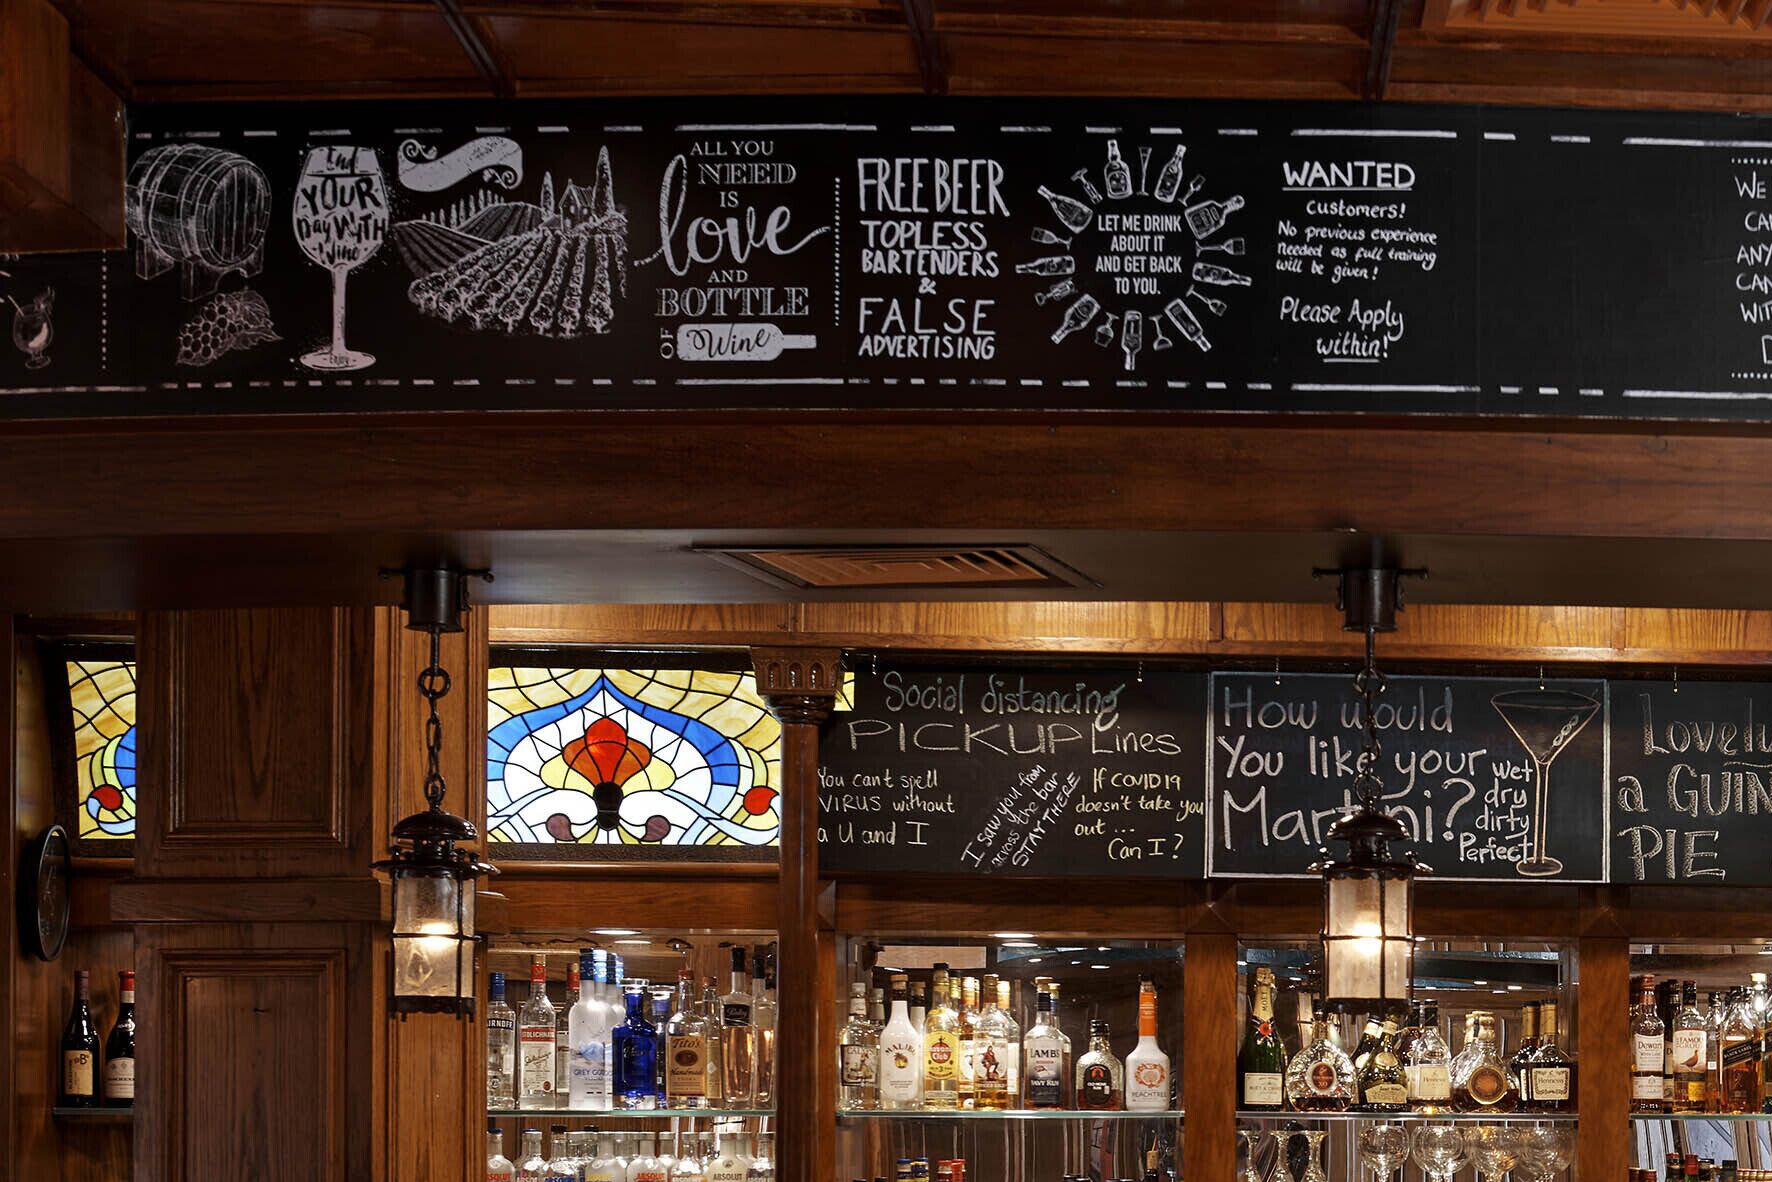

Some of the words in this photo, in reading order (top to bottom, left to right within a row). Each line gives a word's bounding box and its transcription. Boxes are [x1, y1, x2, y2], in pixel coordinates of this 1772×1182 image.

[690, 141, 727, 155] ALL
[731, 141, 774, 155] YOU
[698, 163, 797, 184] NEED
[858, 158, 929, 213] FREE
[935, 158, 1010, 217] BEER
[1282, 161, 1416, 188] WANTED
[301, 177, 381, 216] YOUR
[720, 191, 739, 207] IS
[634, 154, 831, 276] love
[1098, 214, 1119, 232] LET
[1122, 214, 1141, 232] ME
[1144, 214, 1182, 232] DRINK
[860, 220, 987, 250] TOPLESS
[1111, 235, 1150, 252] ABOUT
[1153, 235, 1165, 252] IT
[1278, 220, 1297, 237] No
[1304, 223, 1365, 243] previous
[1371, 228, 1438, 246] experience
[318, 242, 361, 265] Wine
[862, 249, 1000, 278] BARTENDERS
[1096, 256, 1120, 273] AND
[1124, 256, 1147, 273] GET
[1150, 256, 1182, 273] BACK
[1276, 257, 1303, 273] will
[1311, 260, 1324, 275] be
[1331, 246, 1347, 259] as
[1355, 247, 1383, 262] full
[1388, 248, 1437, 271] training
[708, 270, 748, 283] AND
[919, 277, 936, 294] &
[1115, 277, 1130, 295] TO
[1133, 277, 1161, 295] YOU.
[655, 287, 809, 316] BOTTLE
[860, 298, 996, 335] FALSE
[1280, 296, 1341, 323] Please
[1347, 298, 1404, 342] Apply
[660, 328, 674, 359] OF
[686, 324, 770, 358] Wine
[858, 335, 995, 360] ADVERTISING
[1316, 331, 1388, 359] within!
[883, 670, 964, 714] Social
[981, 673, 1126, 731] distancing
[1224, 686, 1317, 729] How
[1092, 726, 1182, 755] Lines
[1093, 768, 1107, 793] If
[1217, 735, 1284, 778] You
[1309, 735, 1374, 778] like
[1381, 748, 1487, 800] your
[817, 766, 844, 788] You
[900, 769, 938, 799] spell
[1484, 780, 1527, 806] dry
[1617, 776, 1648, 813] a
[818, 794, 881, 813] VIRUS
[892, 793, 955, 813] without
[1014, 801, 1039, 824] the
[1032, 772, 1058, 800] bar
[1075, 795, 1132, 813] doesn't
[1138, 795, 1173, 811] take
[1176, 800, 1204, 822] you
[961, 842, 985, 867] I
[997, 787, 1023, 823] you
[1018, 765, 1046, 787] from
[1012, 820, 1046, 867] STAY
[1042, 771, 1081, 824] THERE
[1475, 811, 1529, 840] dirty
[817, 827, 829, 843] a
[839, 821, 854, 843] U
[862, 821, 896, 845] and
[905, 821, 930, 845] I
[1108, 838, 1142, 860] Can
[1459, 833, 1531, 864] Perfect
[1617, 825, 1726, 880] PIE
